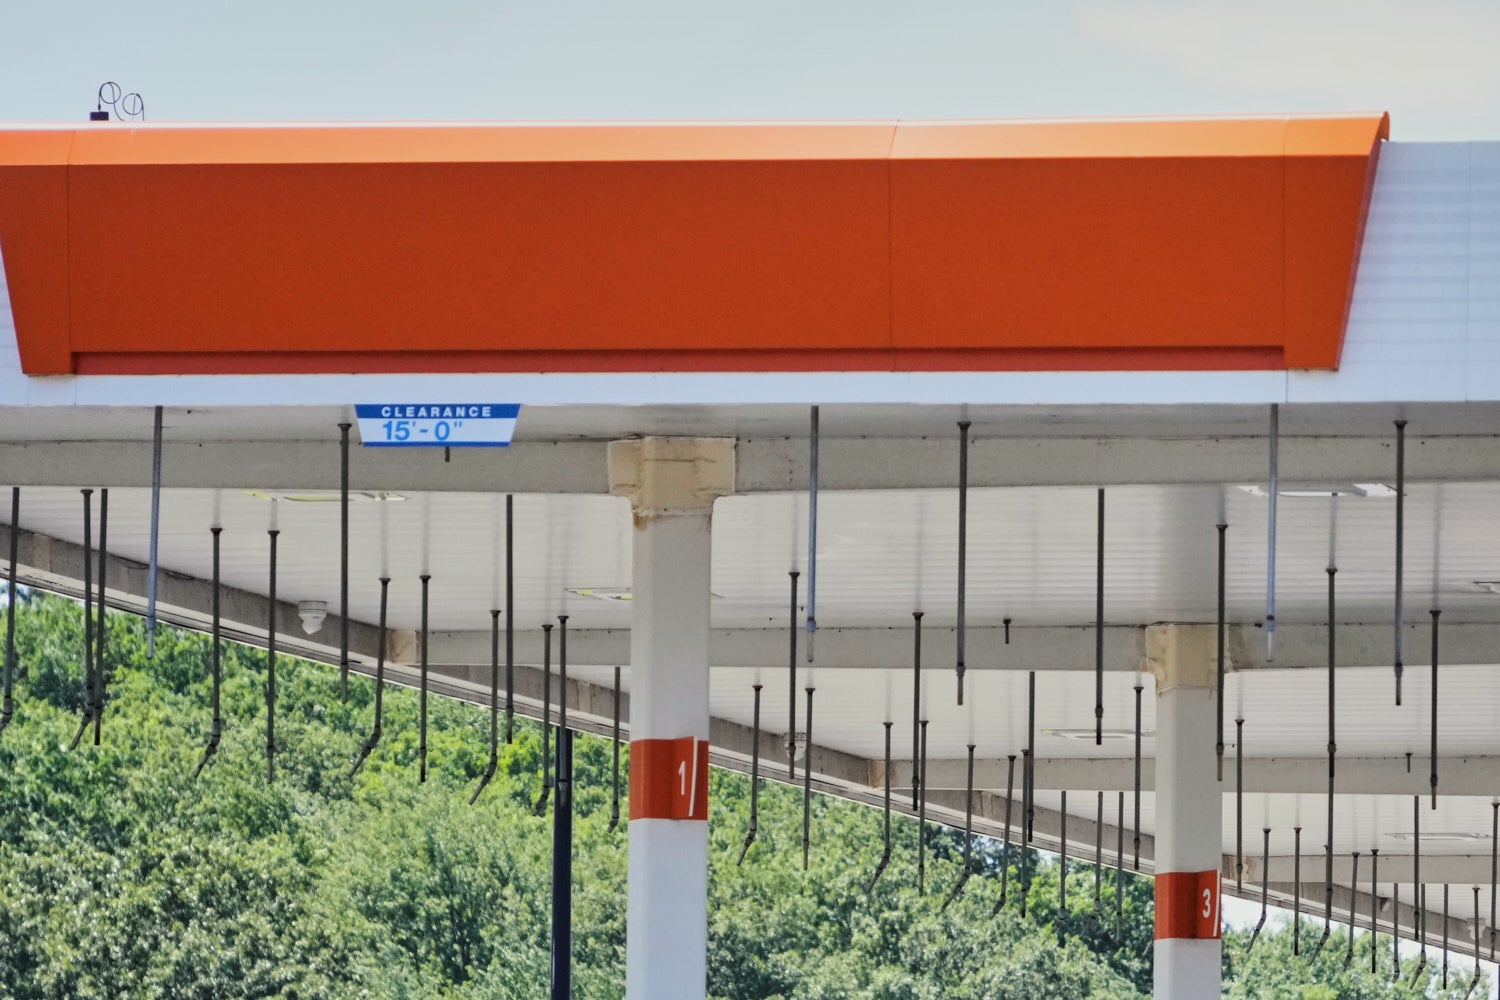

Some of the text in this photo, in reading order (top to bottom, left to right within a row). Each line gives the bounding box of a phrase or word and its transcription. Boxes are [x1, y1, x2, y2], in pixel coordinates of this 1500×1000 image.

[381, 406, 491, 417] CLEARANCE
[679, 760, 685, 795] 1
[1202, 888, 1211, 918] 3
